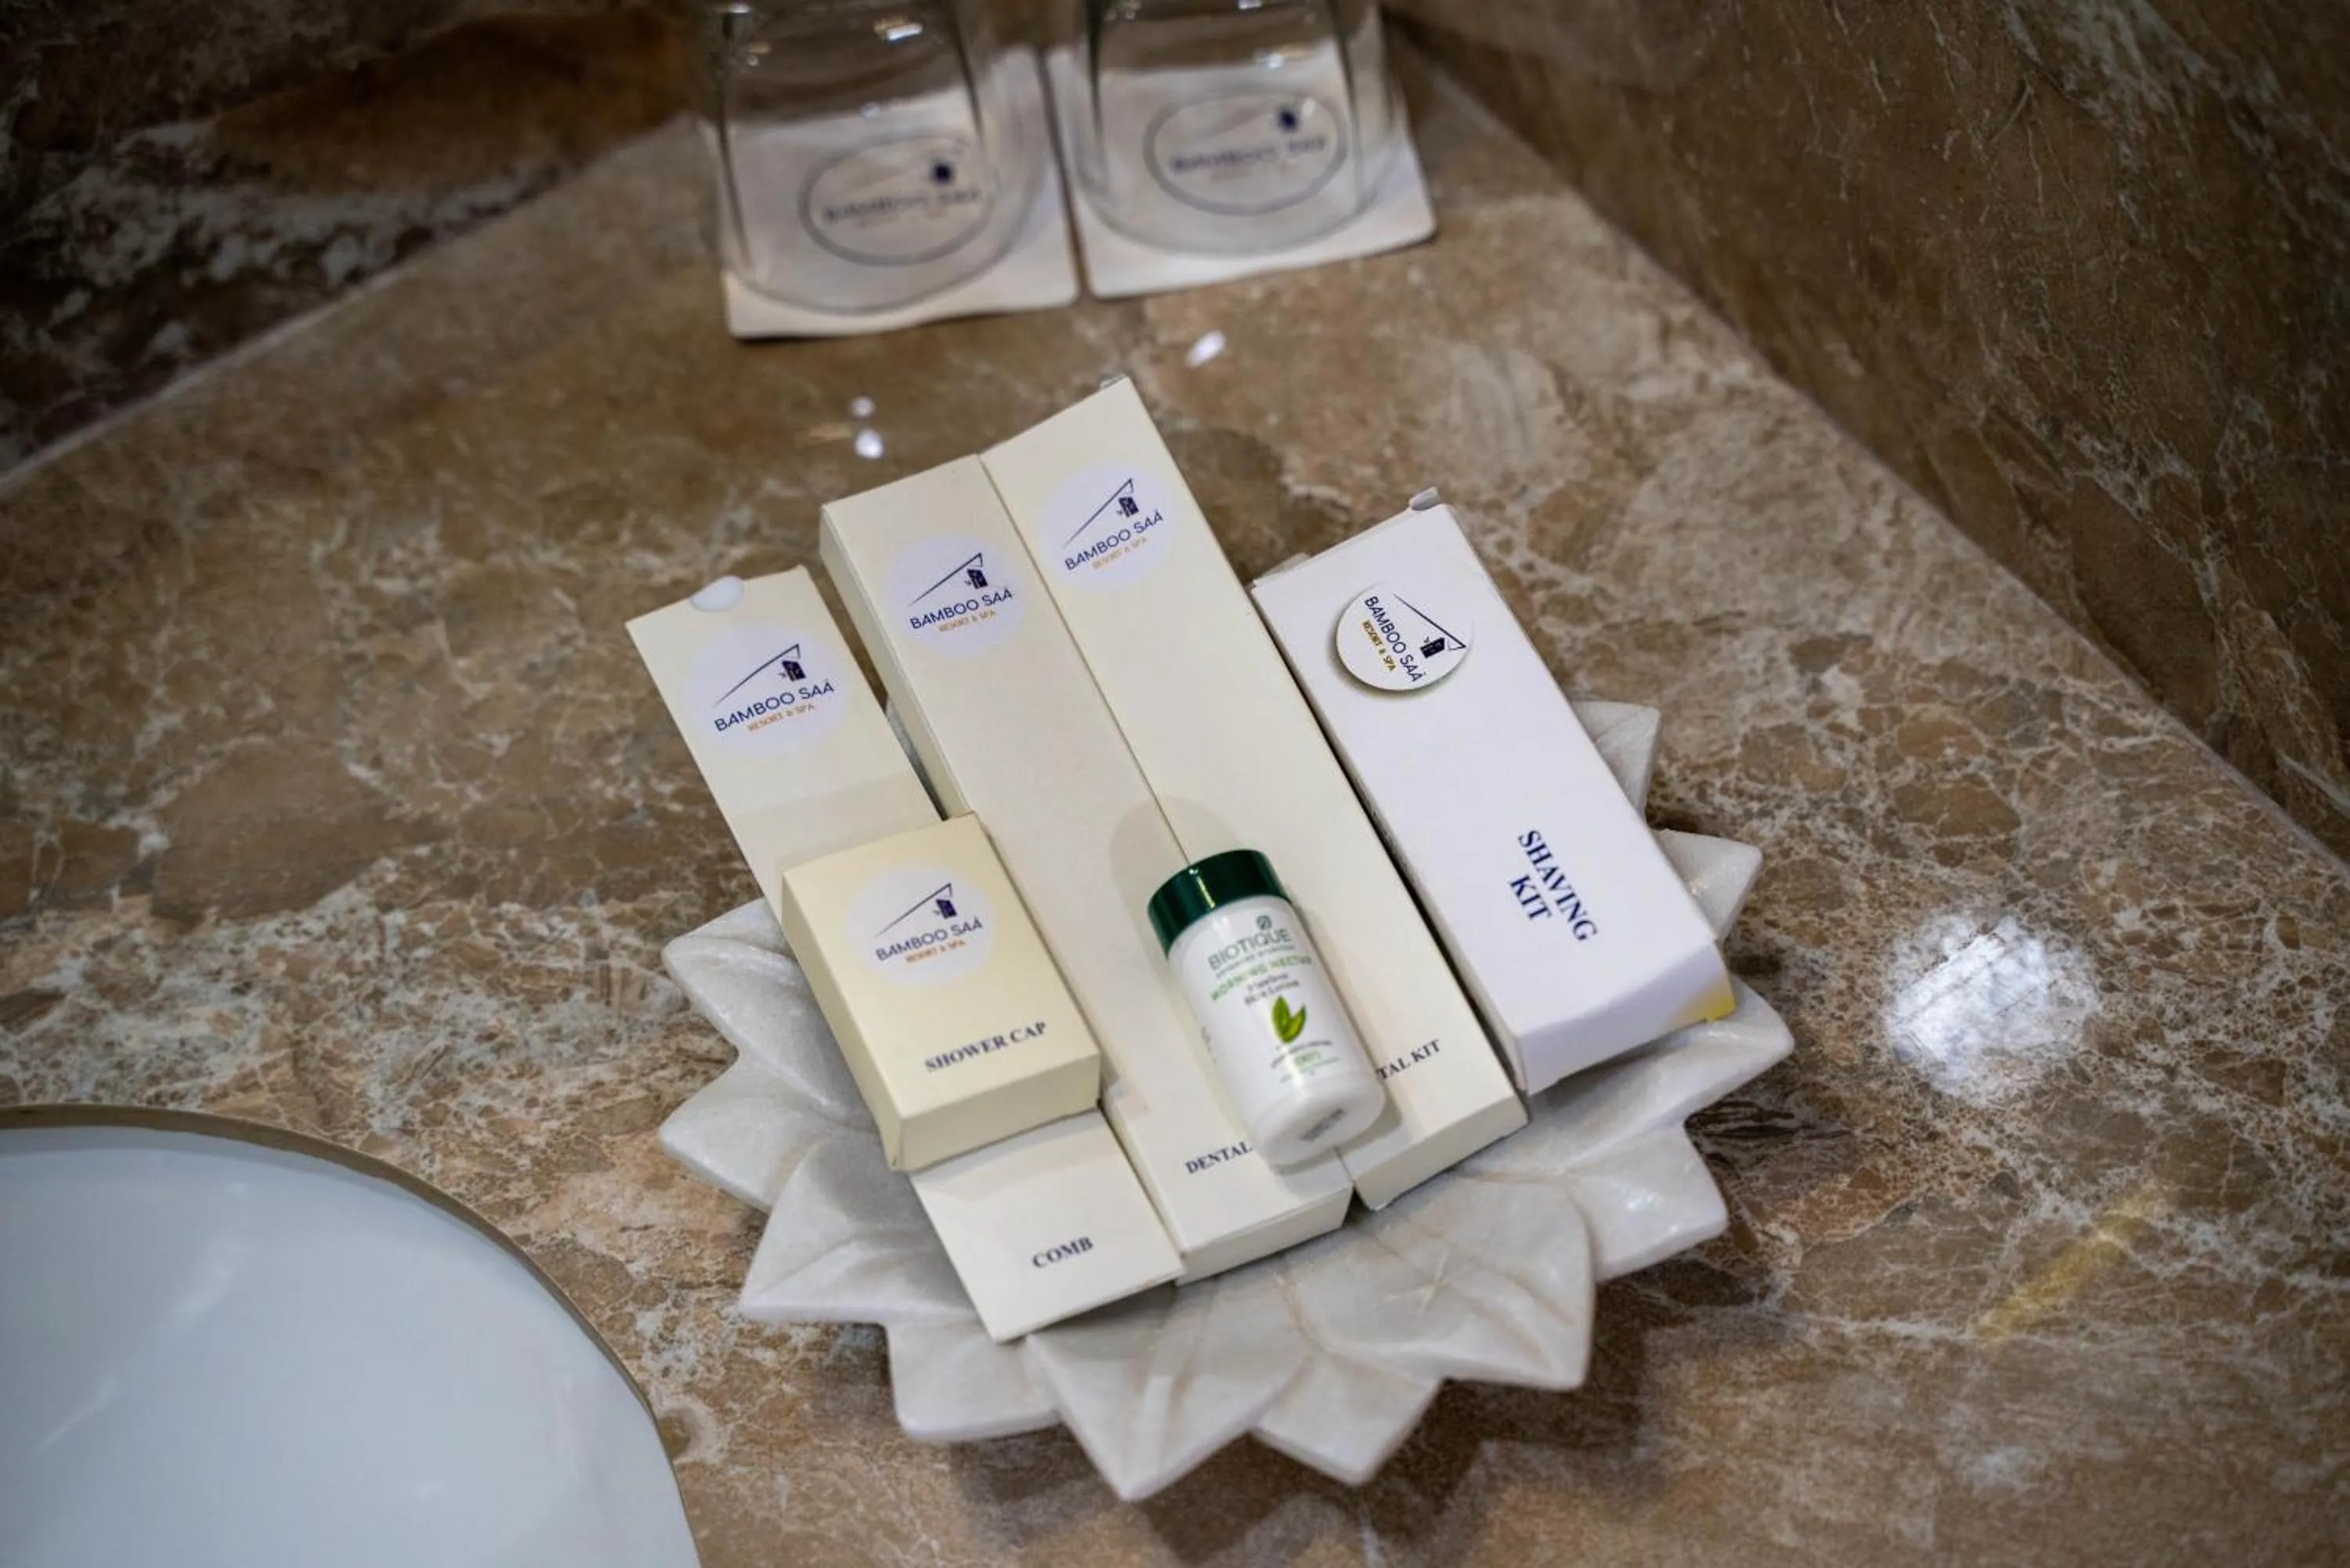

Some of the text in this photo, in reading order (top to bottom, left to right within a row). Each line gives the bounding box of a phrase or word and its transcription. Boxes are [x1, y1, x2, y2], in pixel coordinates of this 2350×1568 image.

[1065, 529, 1131, 570] BAMBOO
[910, 599, 979, 629] BAMBOO
[1365, 596, 1406, 653] BAMBOO
[714, 692, 795, 732] BAMBOO
[1509, 875, 1553, 919] KIT
[1517, 829, 1598, 941] SHAVING
[876, 929, 948, 961] BAMBOO
[1207, 927, 1292, 971] BIOTIQUE
[924, 1021, 1046, 1073] SHOWER CAP
[1375, 1039, 1440, 1078] TAL KIT
[1185, 1141, 1253, 1174] DENTAL
[1032, 1237, 1094, 1268] COMB
